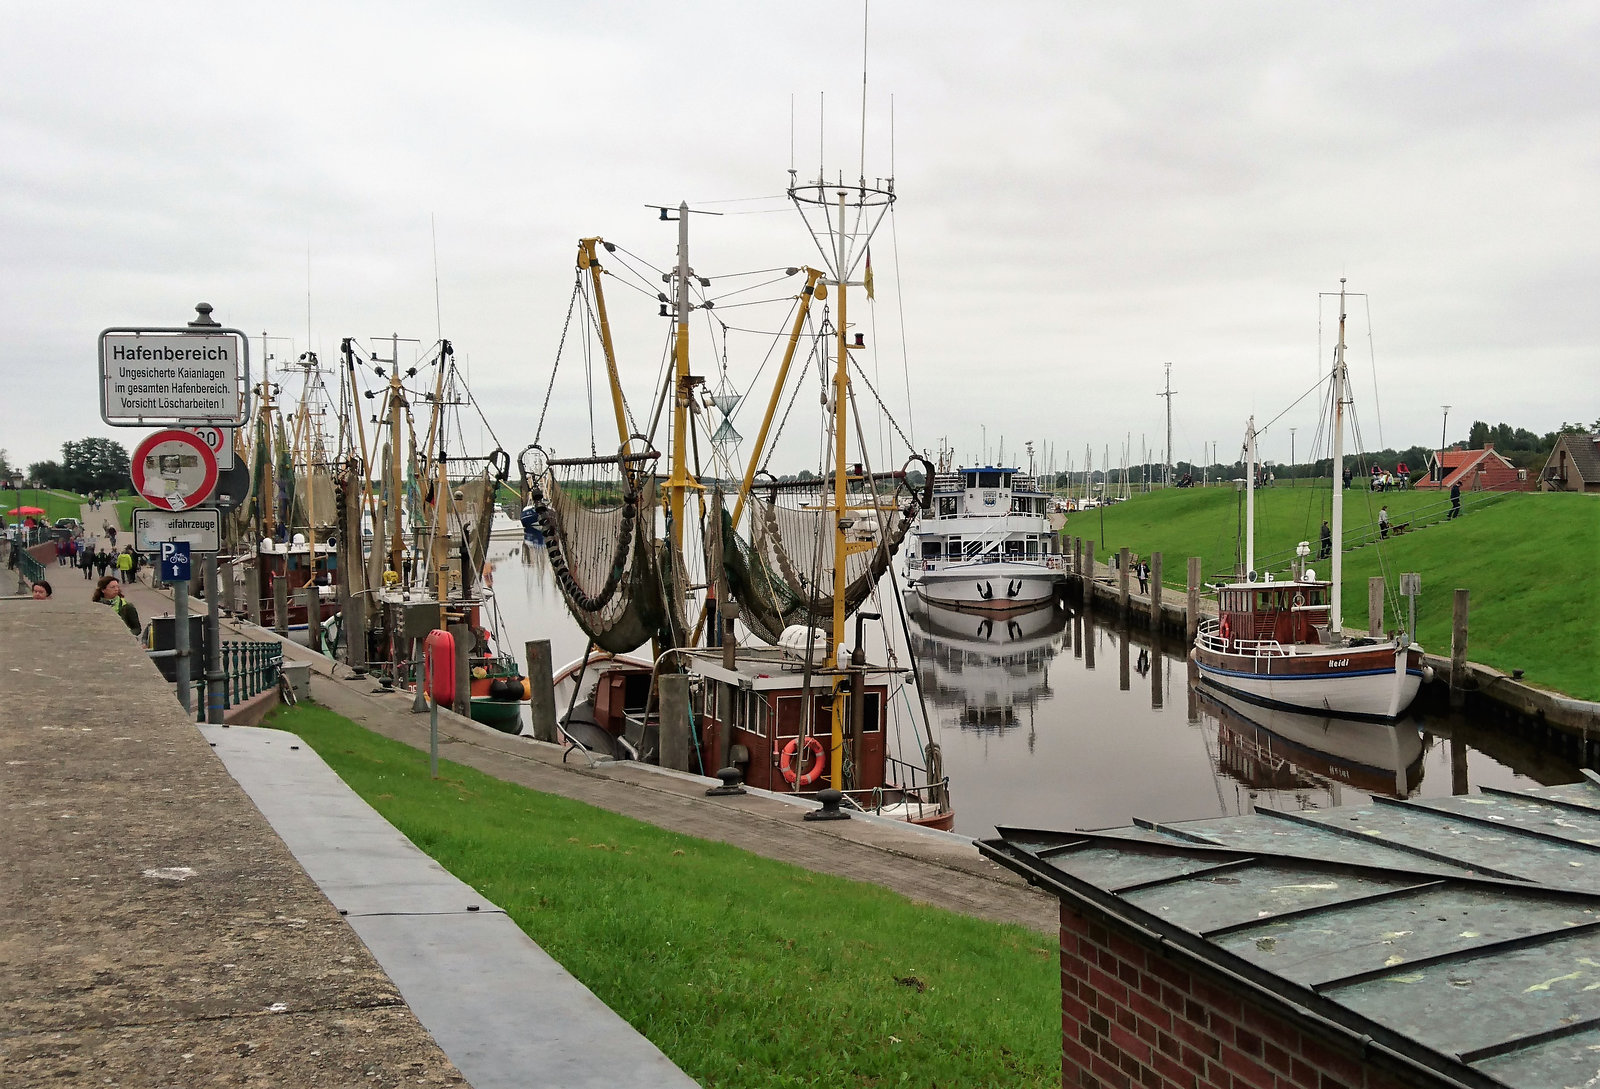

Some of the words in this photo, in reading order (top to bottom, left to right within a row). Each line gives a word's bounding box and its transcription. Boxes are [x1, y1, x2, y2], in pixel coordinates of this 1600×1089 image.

[113, 345, 228, 361] Hafenbereich
[119, 366, 176, 381] Ungesicherte
[177, 367, 225, 382] Kaianlagen
[114, 382, 125, 393] im
[127, 382, 169, 396] gesamten
[171, 382, 231, 394] Hafenbereich.
[120, 397, 157, 409] Vorsicht
[158, 397, 220, 409] Löscharbeiten
[162, 543, 176, 561] P
[1328, 658, 1350, 668] Heidi
